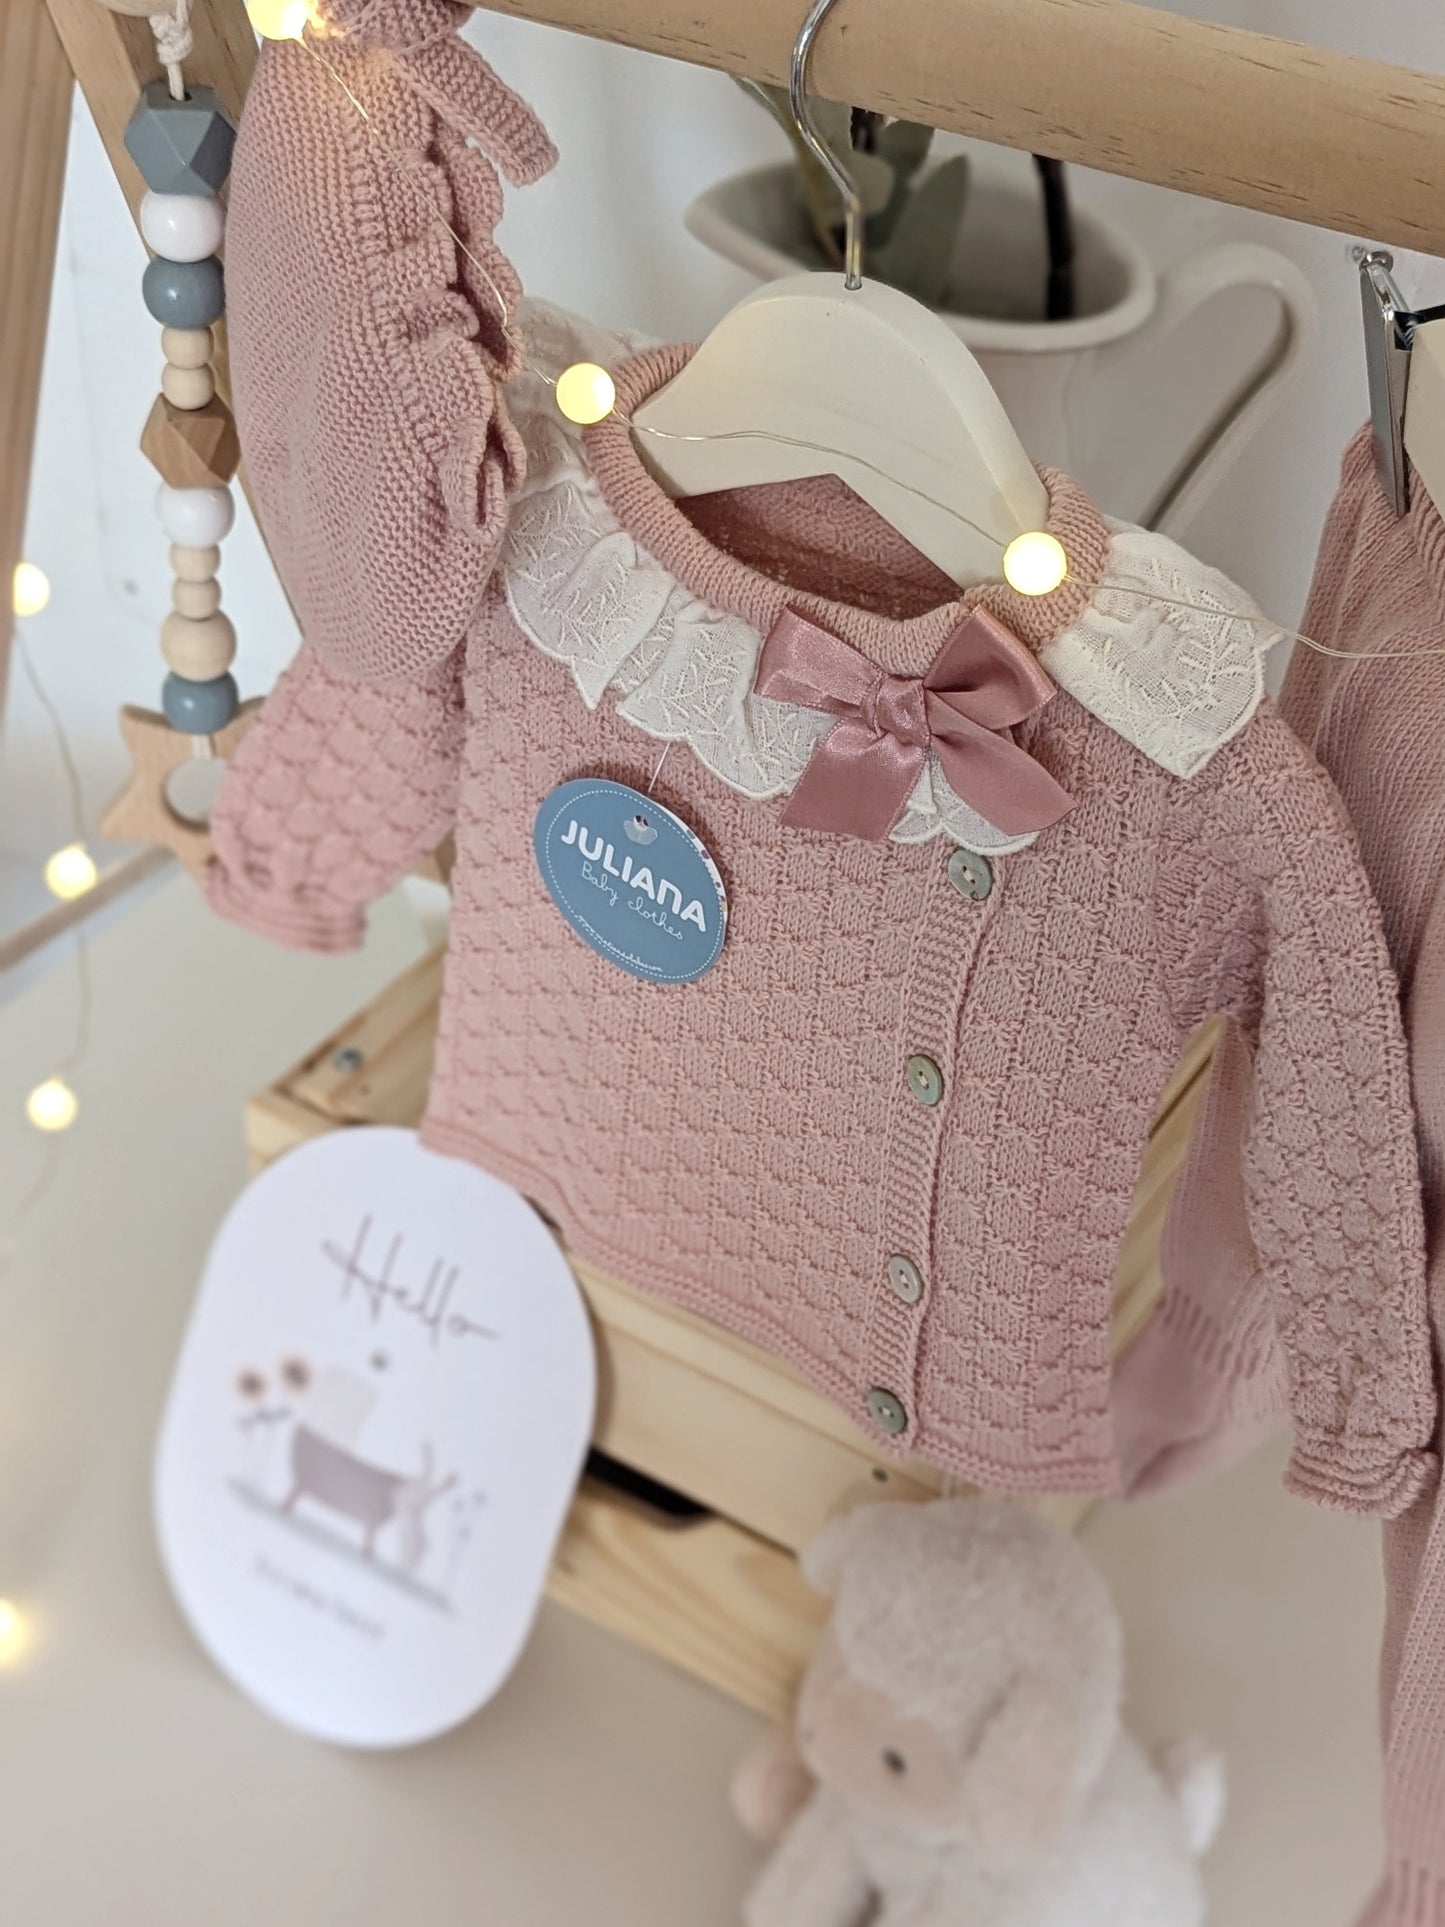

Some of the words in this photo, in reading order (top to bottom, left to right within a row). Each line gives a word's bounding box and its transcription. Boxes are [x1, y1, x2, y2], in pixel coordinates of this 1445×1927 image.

[561, 819, 706, 932] JULIANA
[582, 861, 618, 906] Baby
[628, 897, 683, 940] clothes
[321, 1213, 499, 1348] Hello
